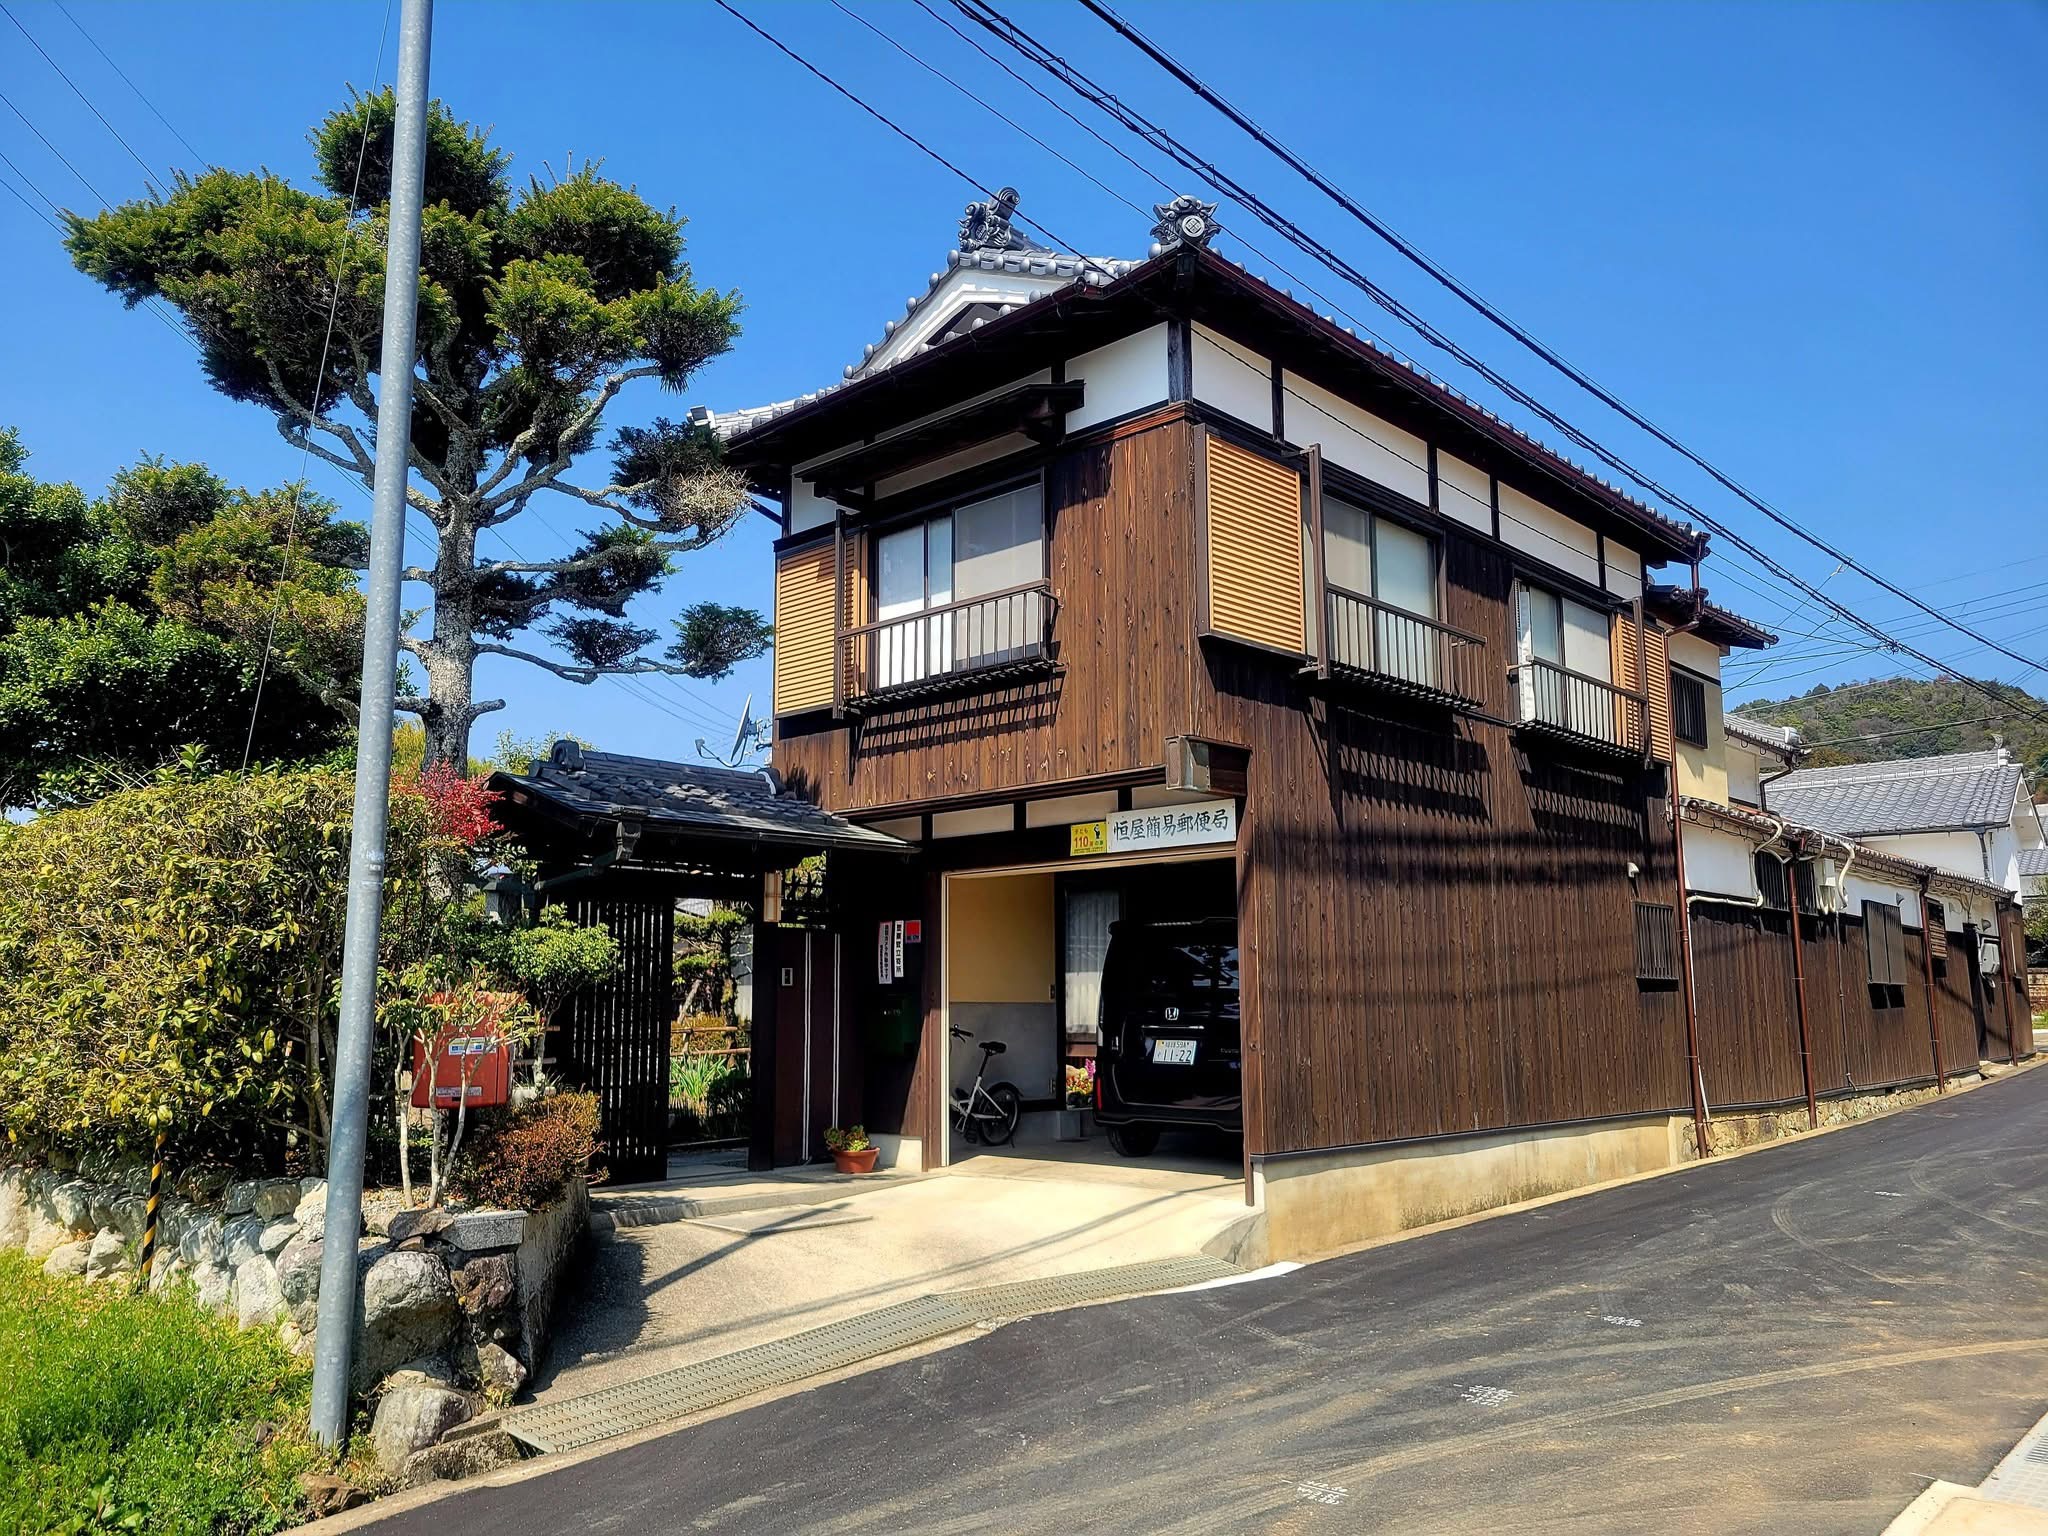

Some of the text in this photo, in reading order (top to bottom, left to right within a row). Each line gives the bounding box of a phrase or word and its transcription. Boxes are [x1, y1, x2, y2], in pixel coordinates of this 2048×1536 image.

[1113, 809, 1229, 842] 恒屋簡易郵便局
[1163, 1049, 1192, 1062] 11-22
